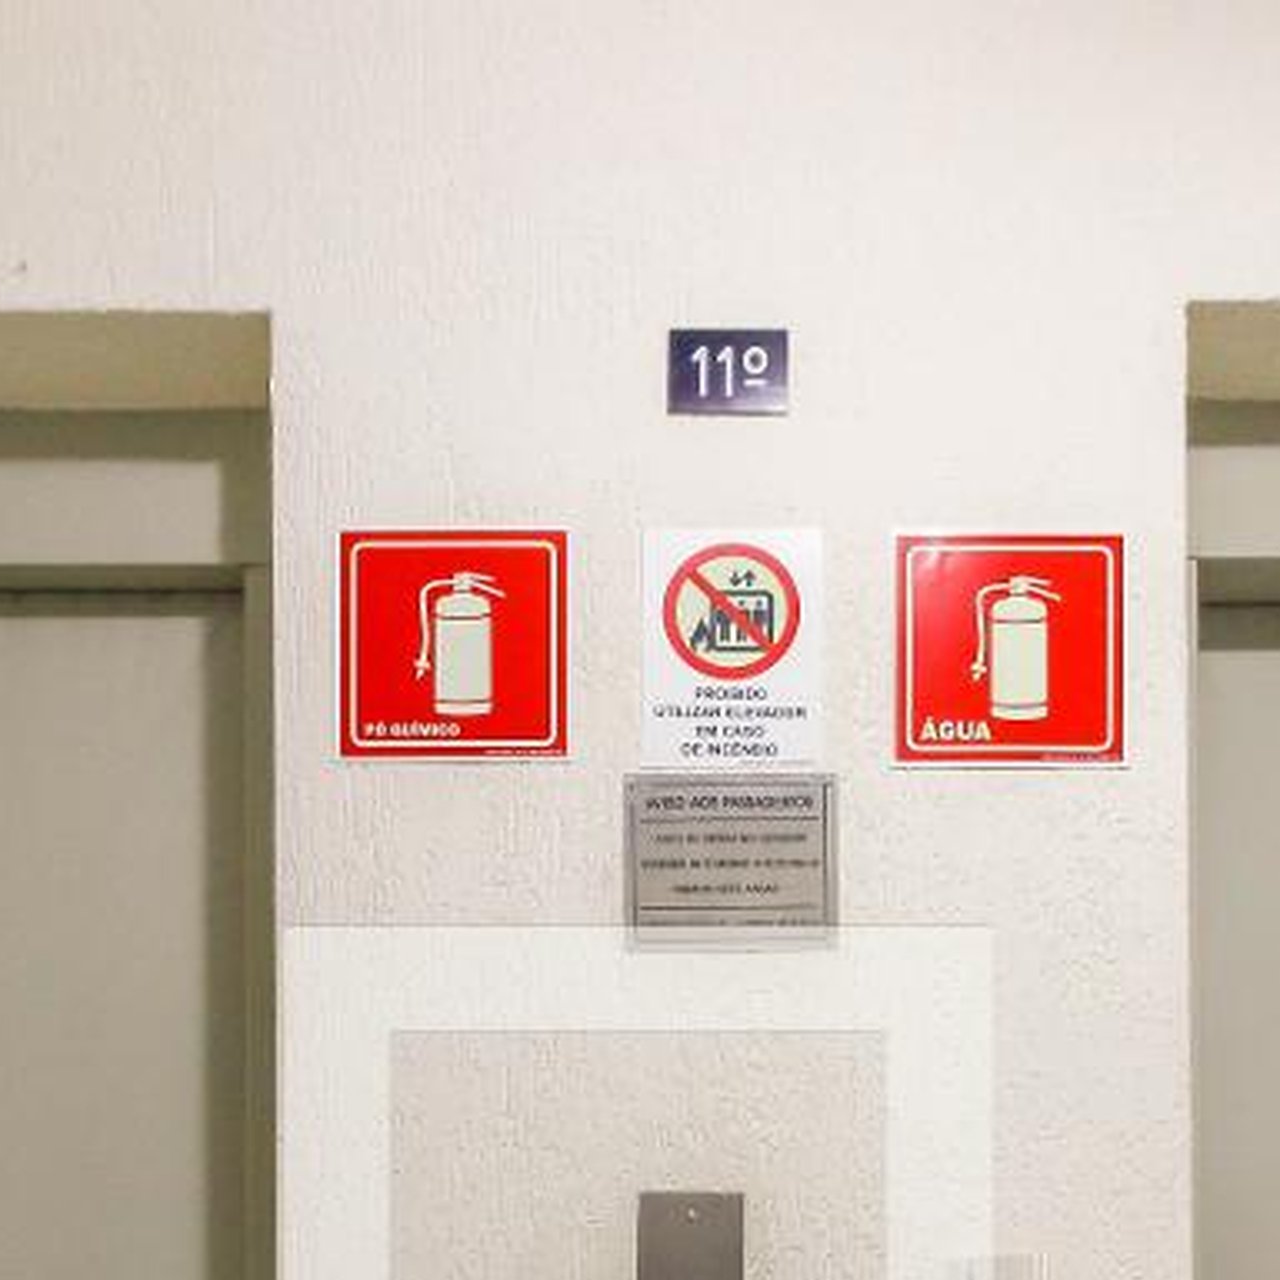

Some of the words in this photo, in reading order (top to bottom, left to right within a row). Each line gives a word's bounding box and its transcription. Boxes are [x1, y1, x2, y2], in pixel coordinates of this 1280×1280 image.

[695, 685, 768, 701] PROIBIDO
[652, 705, 721, 718] UTILIZAR
[725, 706, 808, 719] ELEVADOR
[694, 725, 718, 738] EM
[722, 725, 766, 738] CASO
[919, 715, 992, 741] ÁGUA
[680, 743, 704, 758] DE
